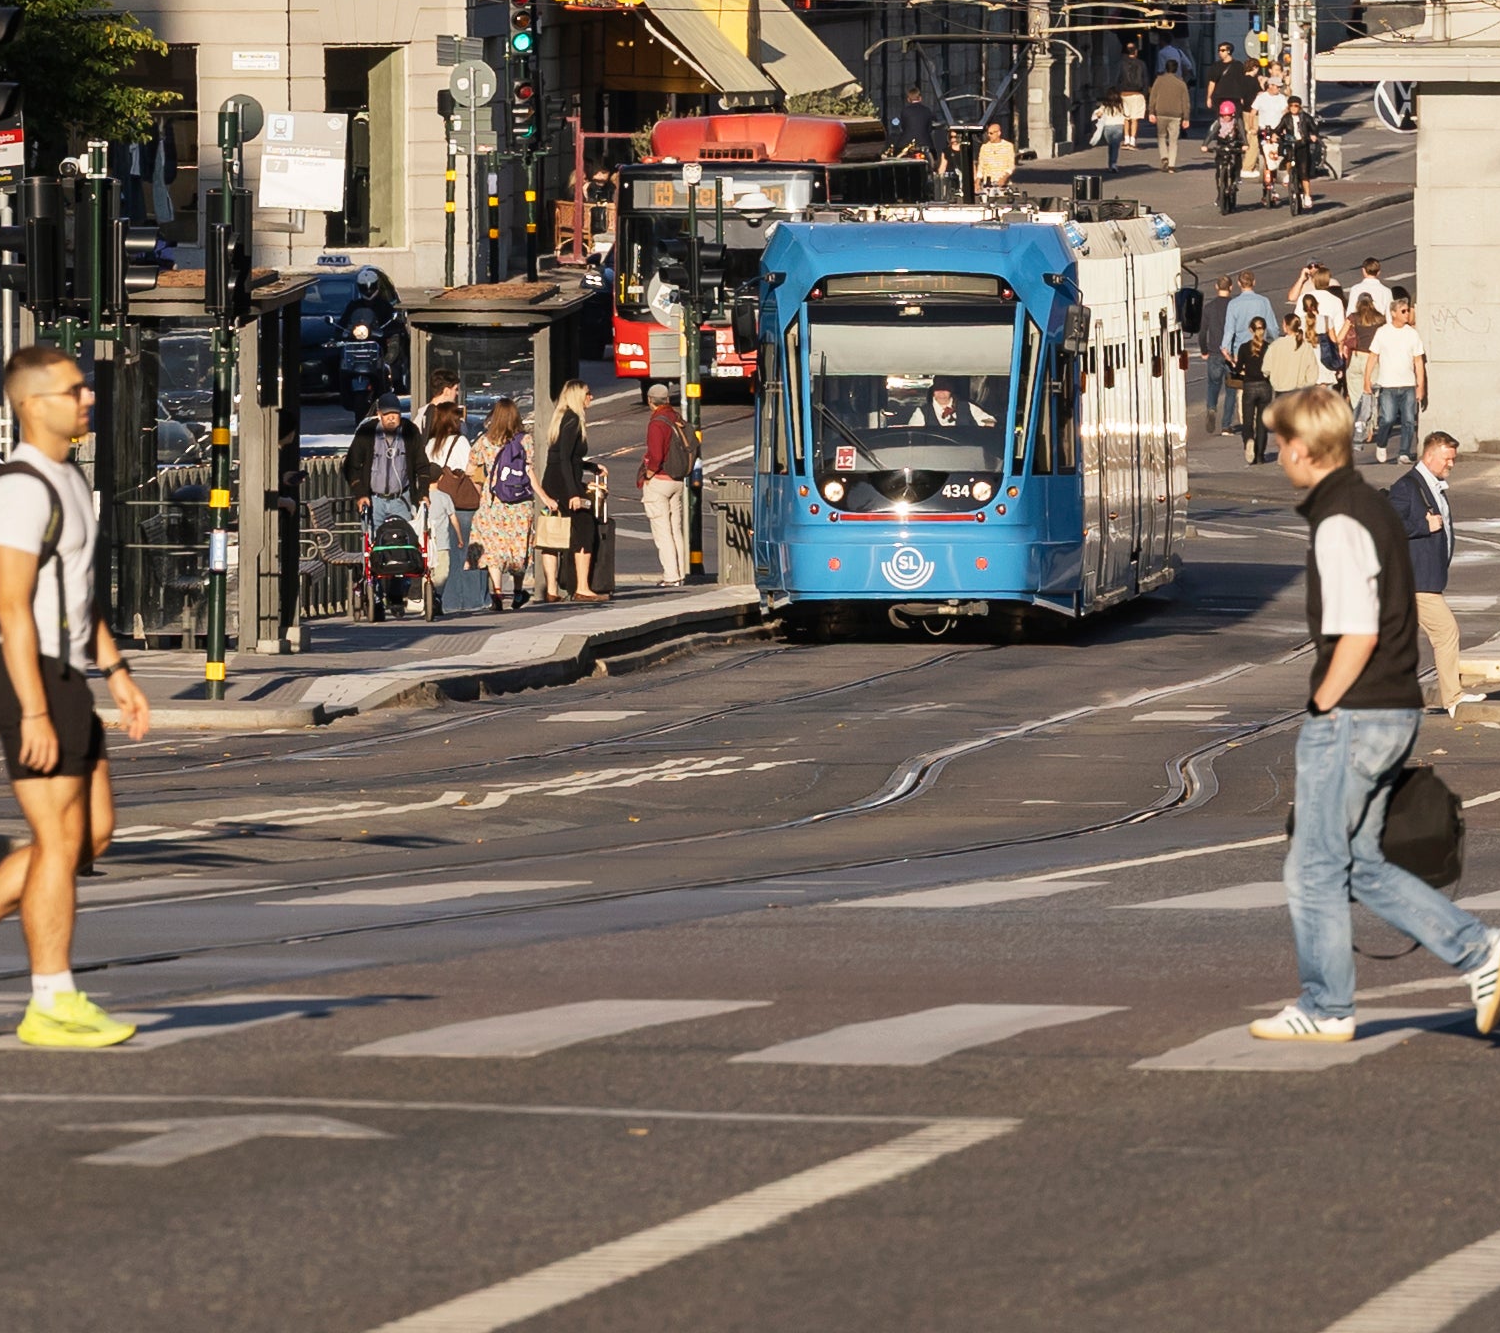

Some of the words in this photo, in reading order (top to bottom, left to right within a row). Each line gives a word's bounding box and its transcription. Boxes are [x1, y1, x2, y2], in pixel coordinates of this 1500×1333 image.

[837, 455, 853, 468] 12
[941, 484, 970, 498] 434
[897, 555, 918, 570] SL
